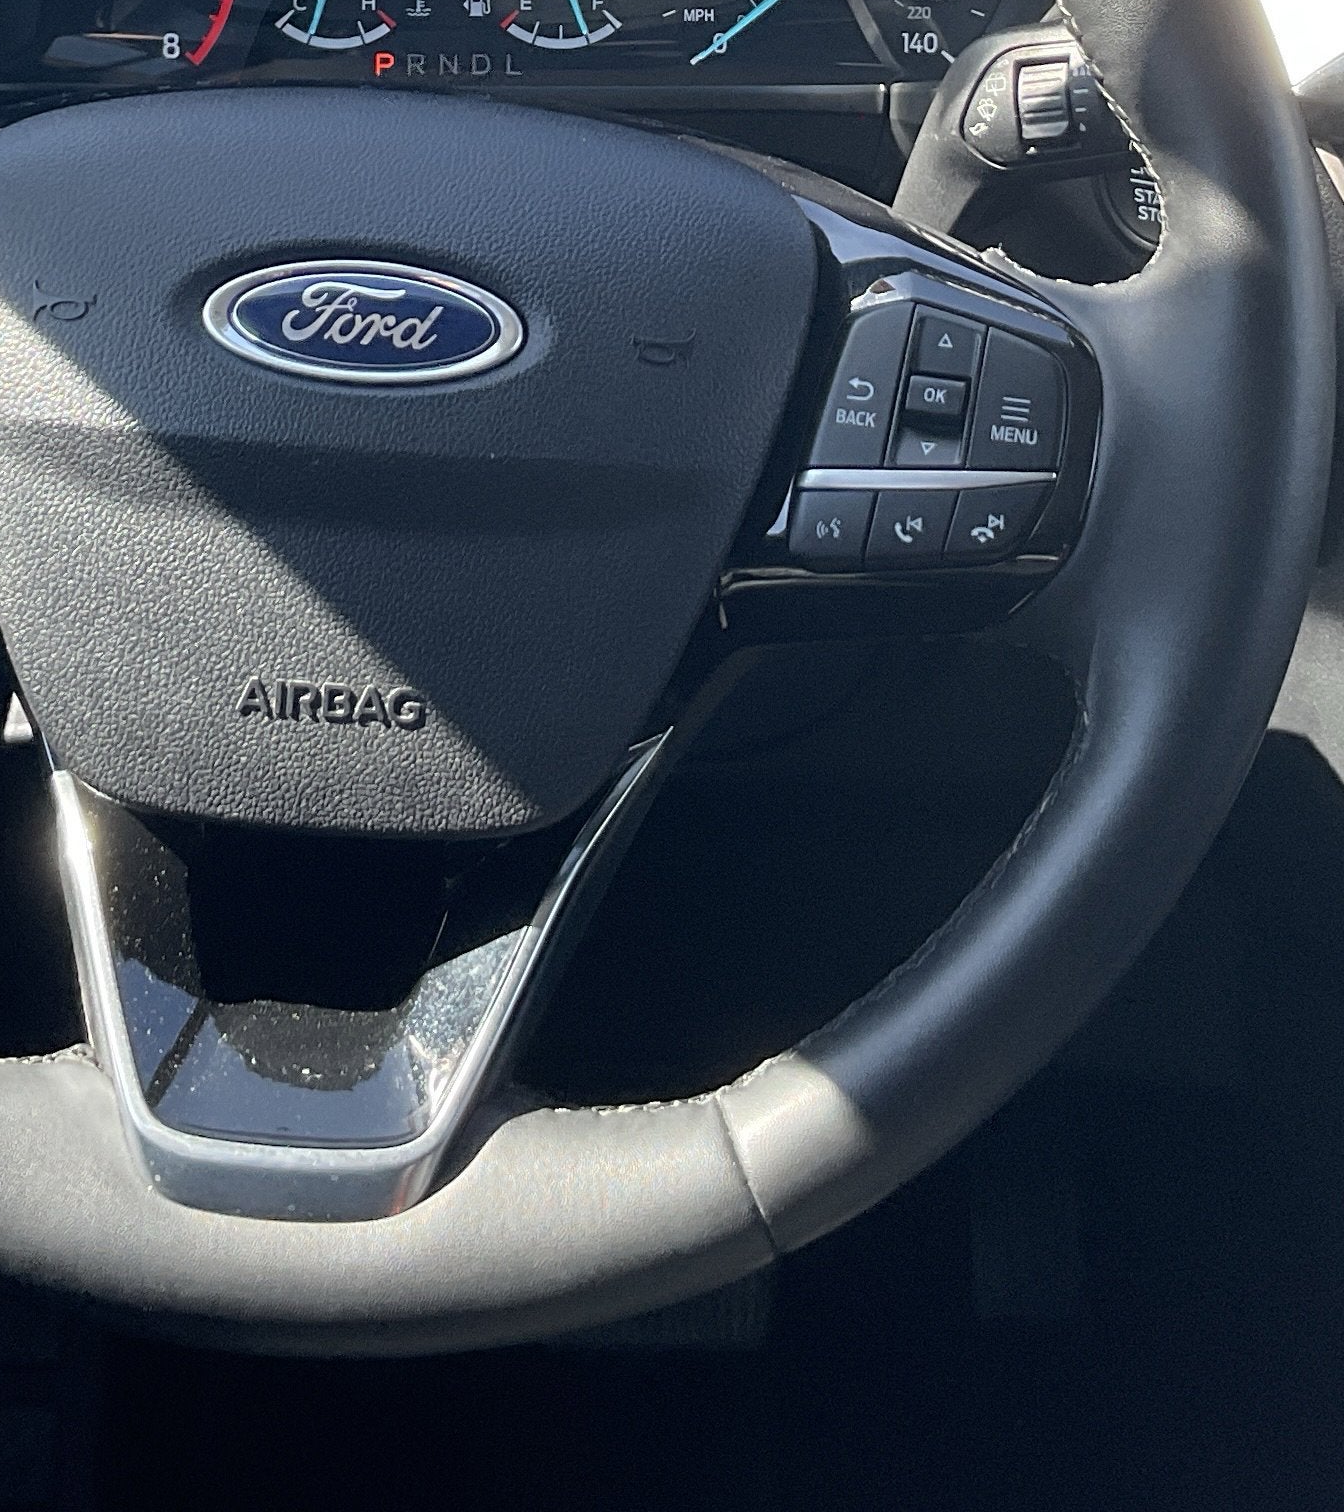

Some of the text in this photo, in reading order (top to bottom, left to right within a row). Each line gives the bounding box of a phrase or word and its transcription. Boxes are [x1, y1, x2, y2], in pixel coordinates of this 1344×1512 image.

[684, 9, 714, 22] MPH
[907, 6, 931, 19] 220
[162, 33, 180, 59] 8
[902, 32, 938, 53] 140
[1134, 188, 1160, 204] STA
[281, 281, 444, 351] Ford
[924, 388, 947, 403] OK
[836, 408, 876, 427] BACK
[991, 425, 1037, 444] MENU
[236, 676, 428, 731] AIRBAG
